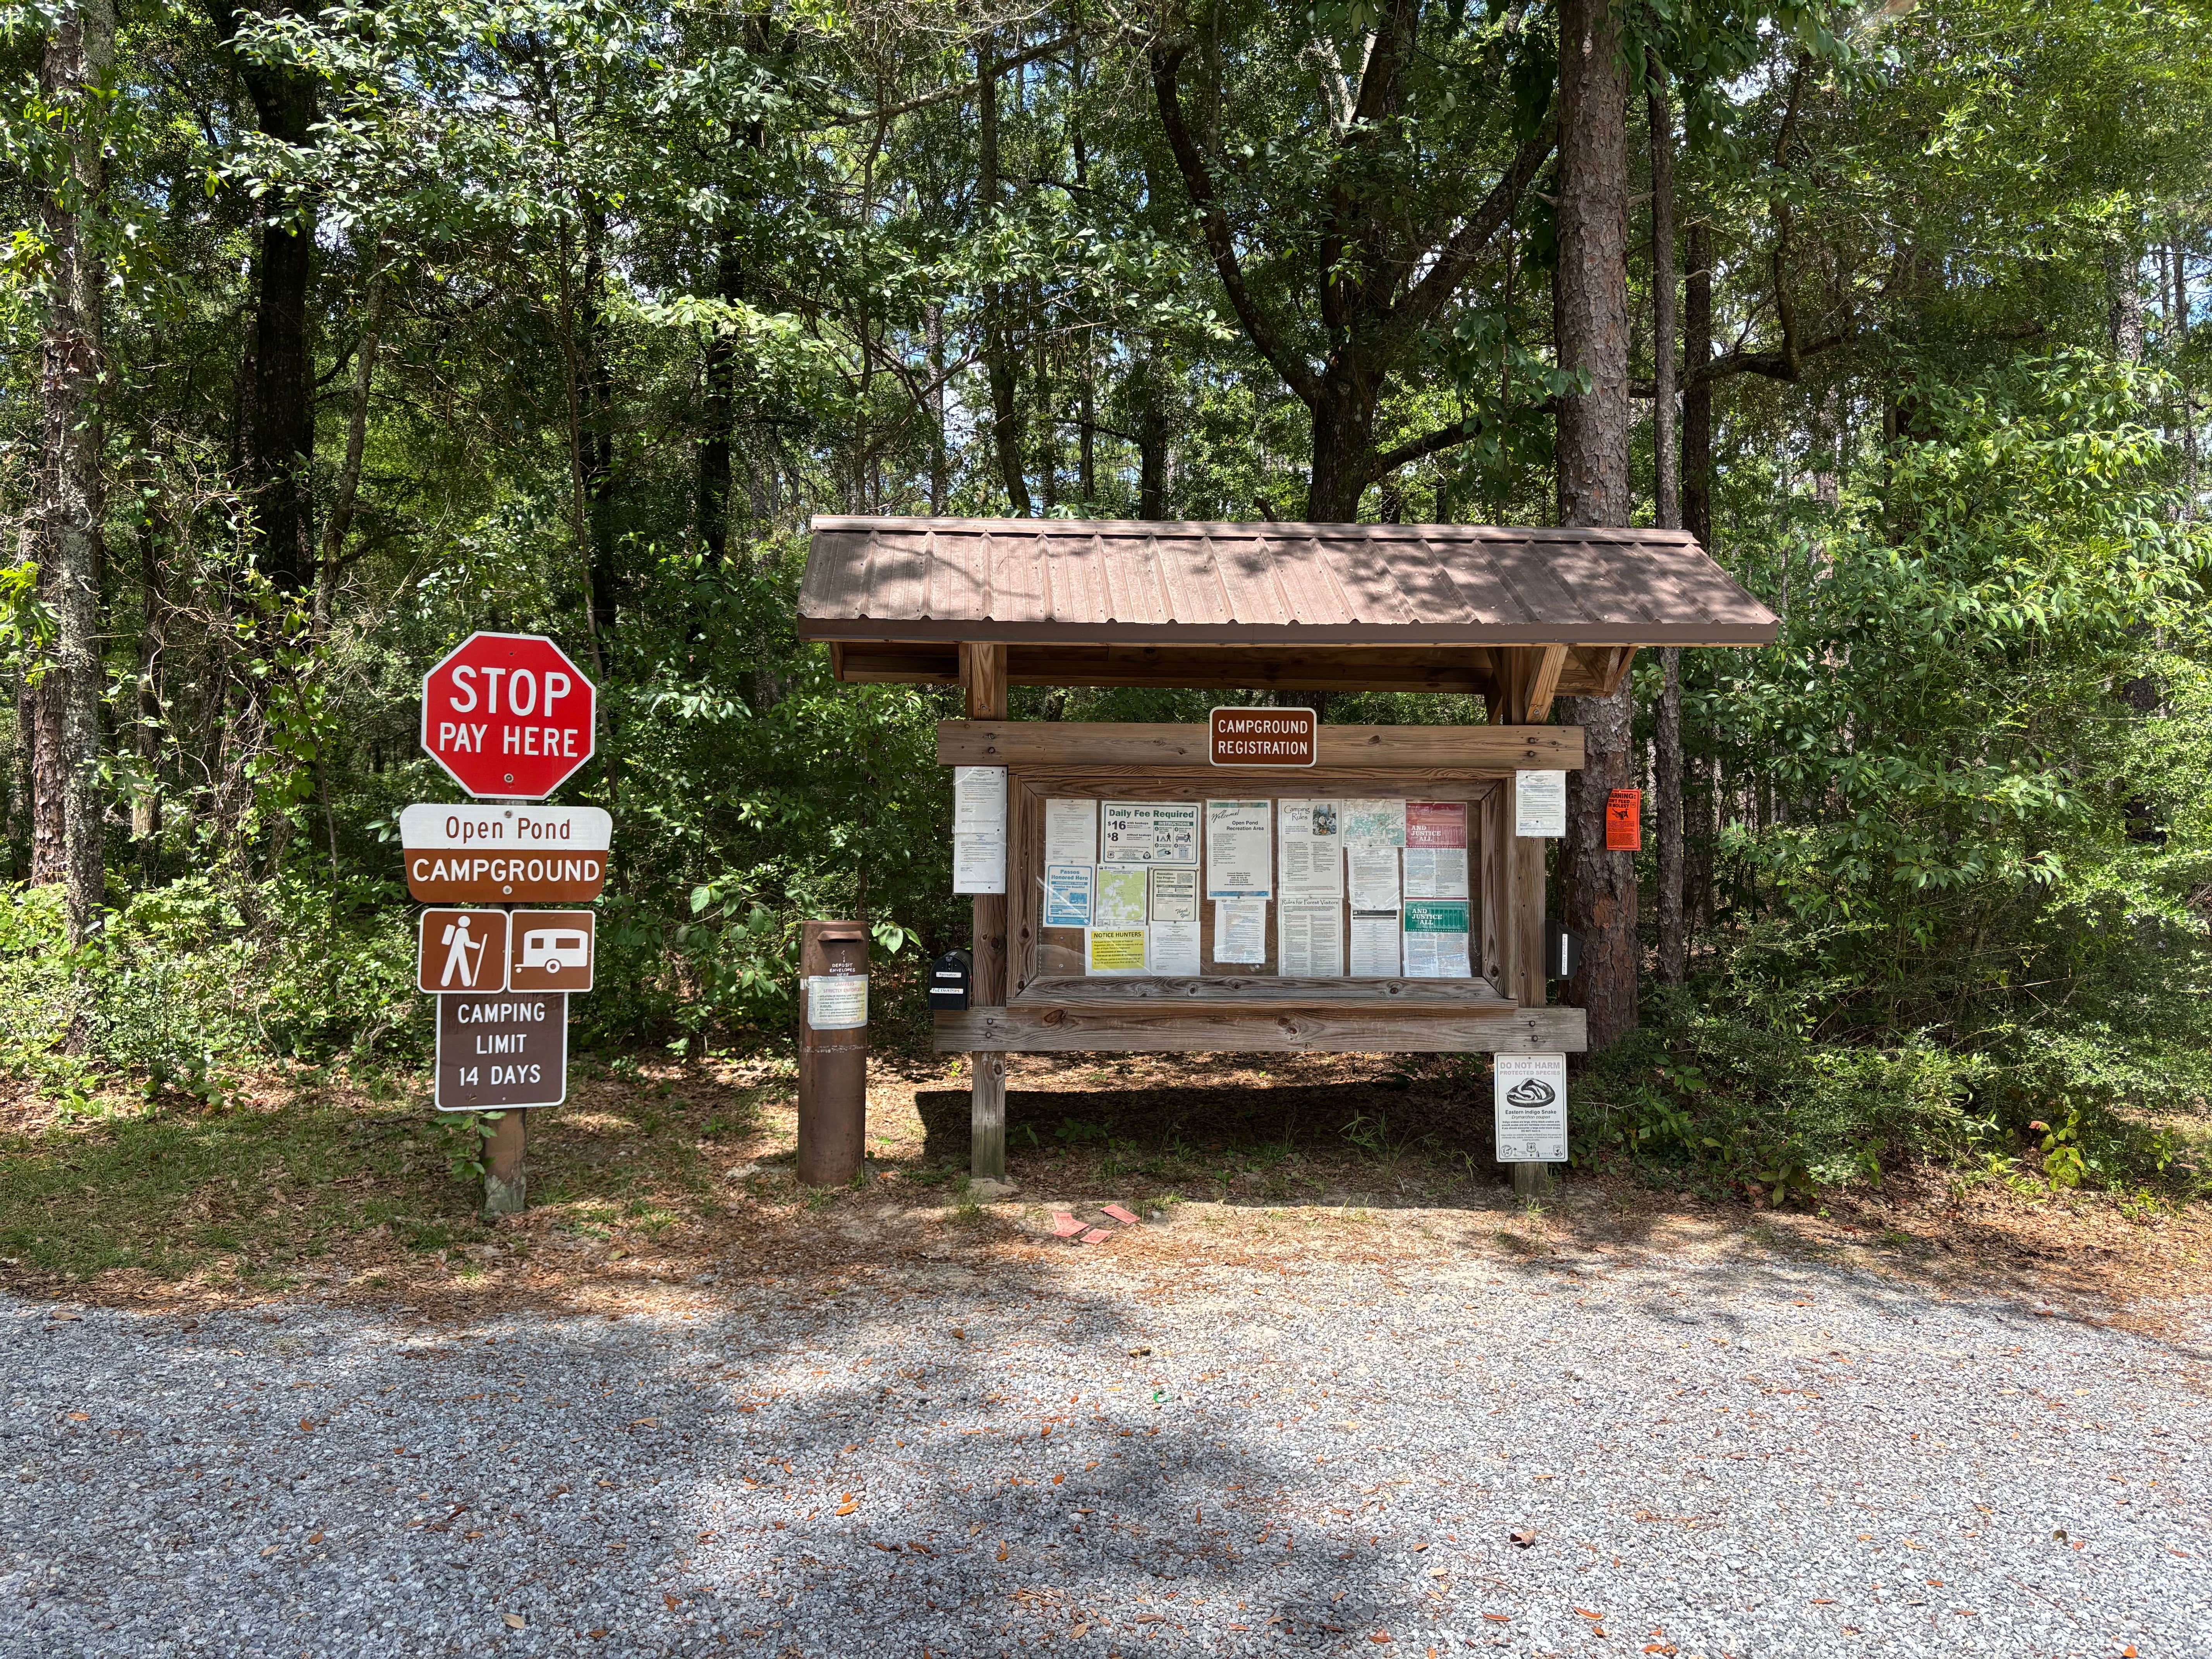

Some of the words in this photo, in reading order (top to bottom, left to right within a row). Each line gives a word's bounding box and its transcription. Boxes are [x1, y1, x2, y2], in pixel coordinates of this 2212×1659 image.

[450, 665, 571, 717] STOP
[1218, 720, 1308, 734] CAMPGROUND
[440, 723, 488, 753] PAY
[503, 725, 578, 757] HERE
[1218, 741, 1307, 755] REGISTRATION
[1109, 809, 1131, 818] Daily
[1153, 810, 1194, 819] Required
[1211, 809, 1239, 823] Welcome!
[1284, 805, 1310, 814] Camping
[1292, 813, 1308, 821] Rules
[446, 816, 503, 844] Open
[518, 817, 570, 840] Pond
[1108, 820, 1126, 830] $16
[1108, 832, 1118, 842] $8
[413, 859, 599, 882] CAMPGROUND
[458, 1003, 545, 1024] CAMPING
[476, 1034, 527, 1054] LIMIT
[459, 1066, 479, 1086] 14
[491, 1064, 541, 1085] DAYS
